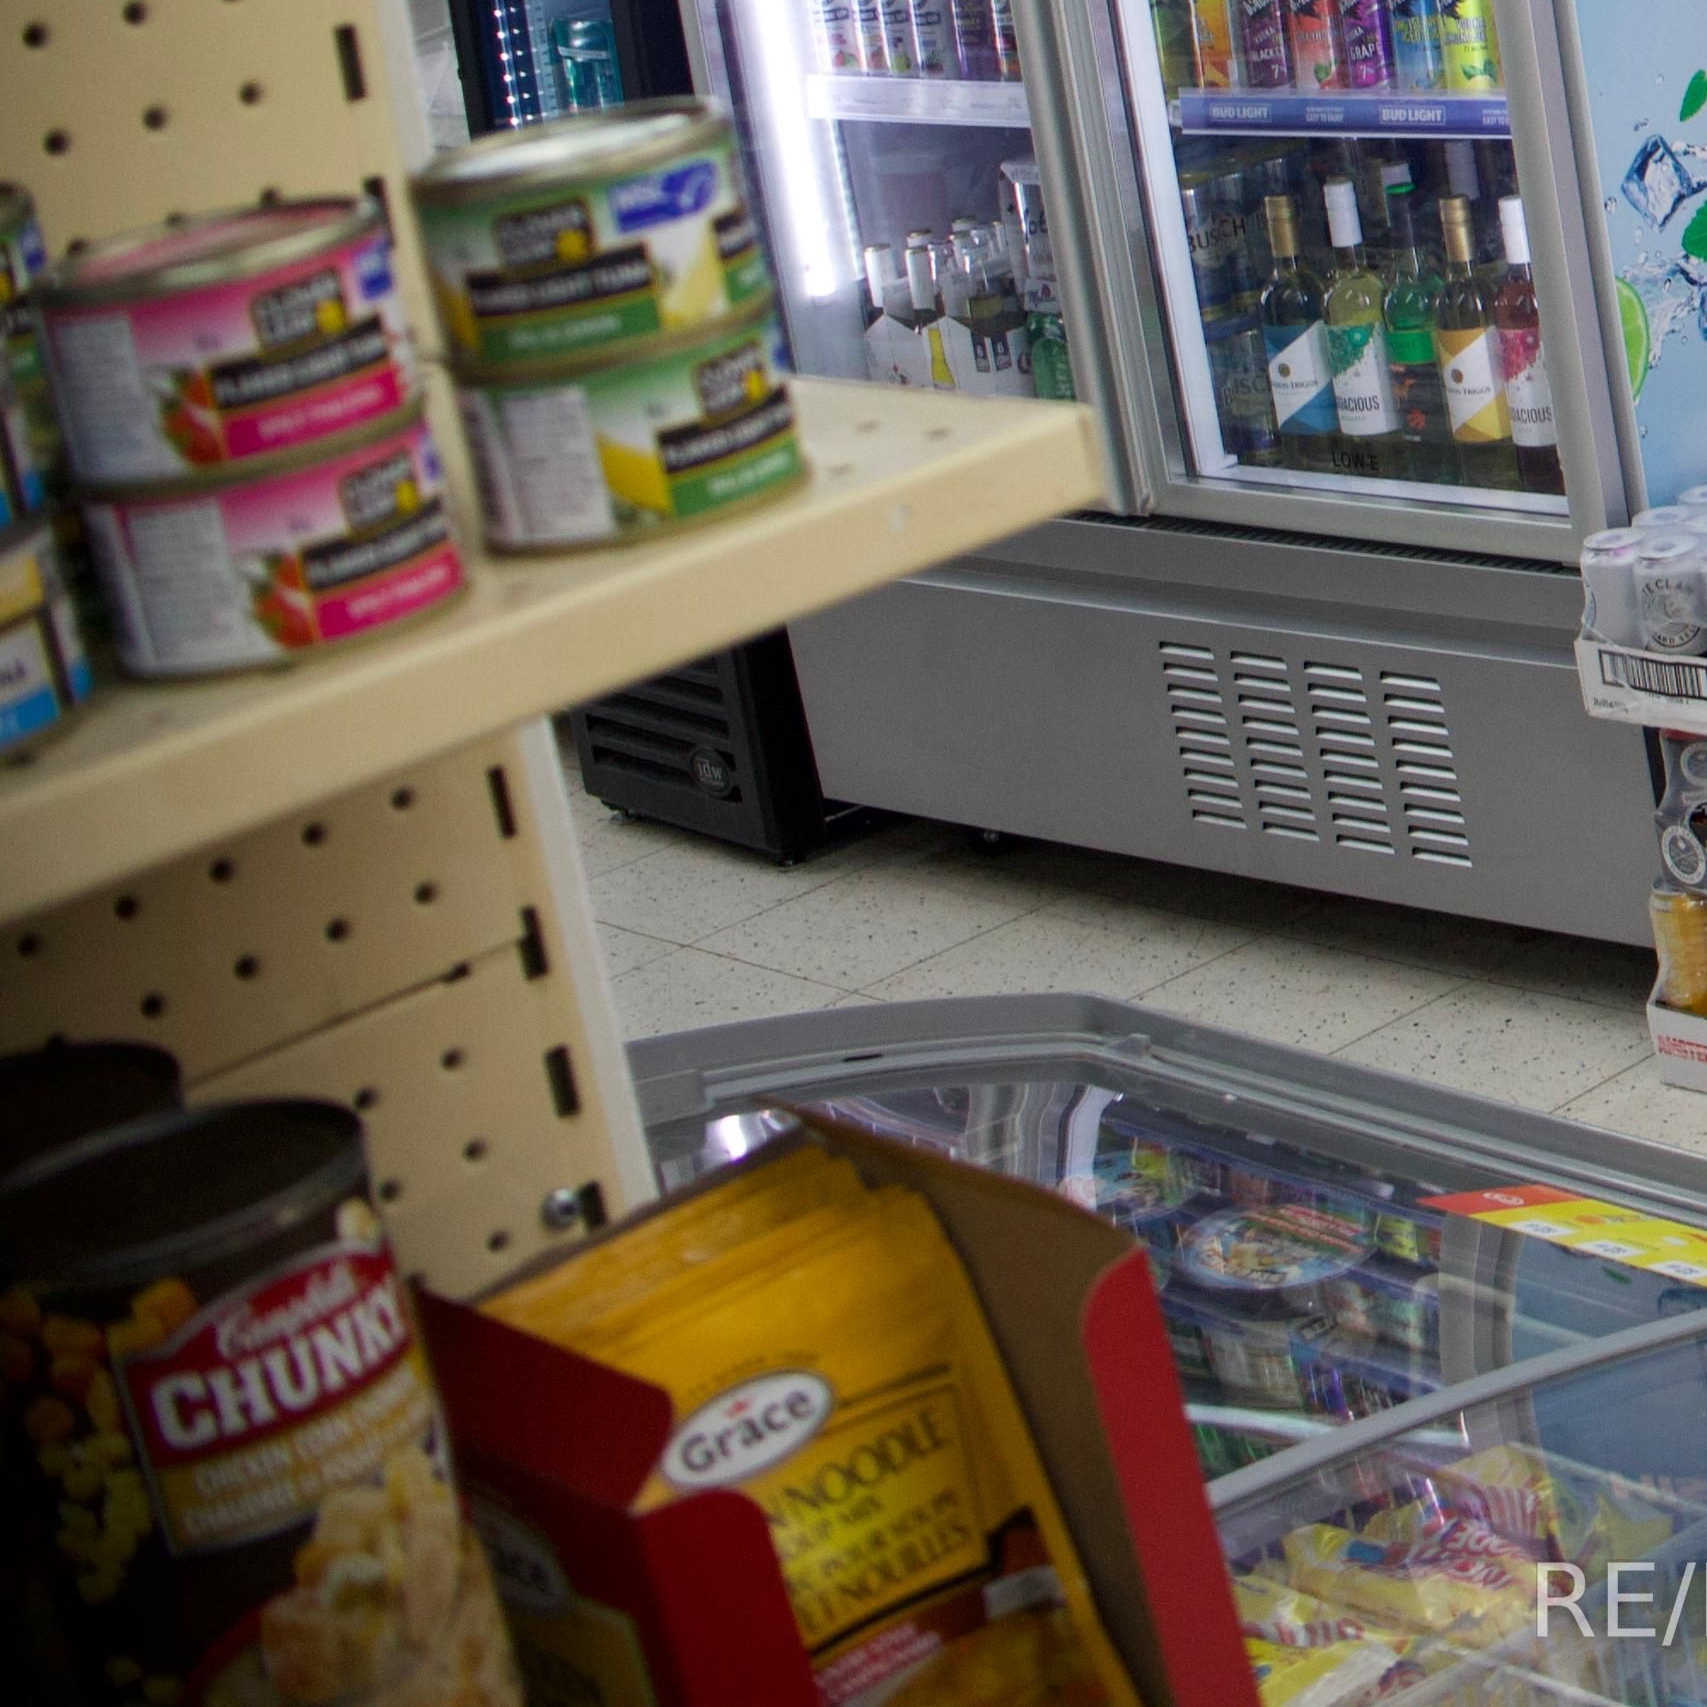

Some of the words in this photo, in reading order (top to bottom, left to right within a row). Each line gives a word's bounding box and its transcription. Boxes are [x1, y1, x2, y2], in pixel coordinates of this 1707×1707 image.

[1212, 107, 1234, 120] BUD
[1236, 106, 1268, 120] LIGHT
[1382, 109, 1406, 122] BUD
[1408, 108, 1442, 122] LIGHT
[680, 1383, 815, 1475] Grace
